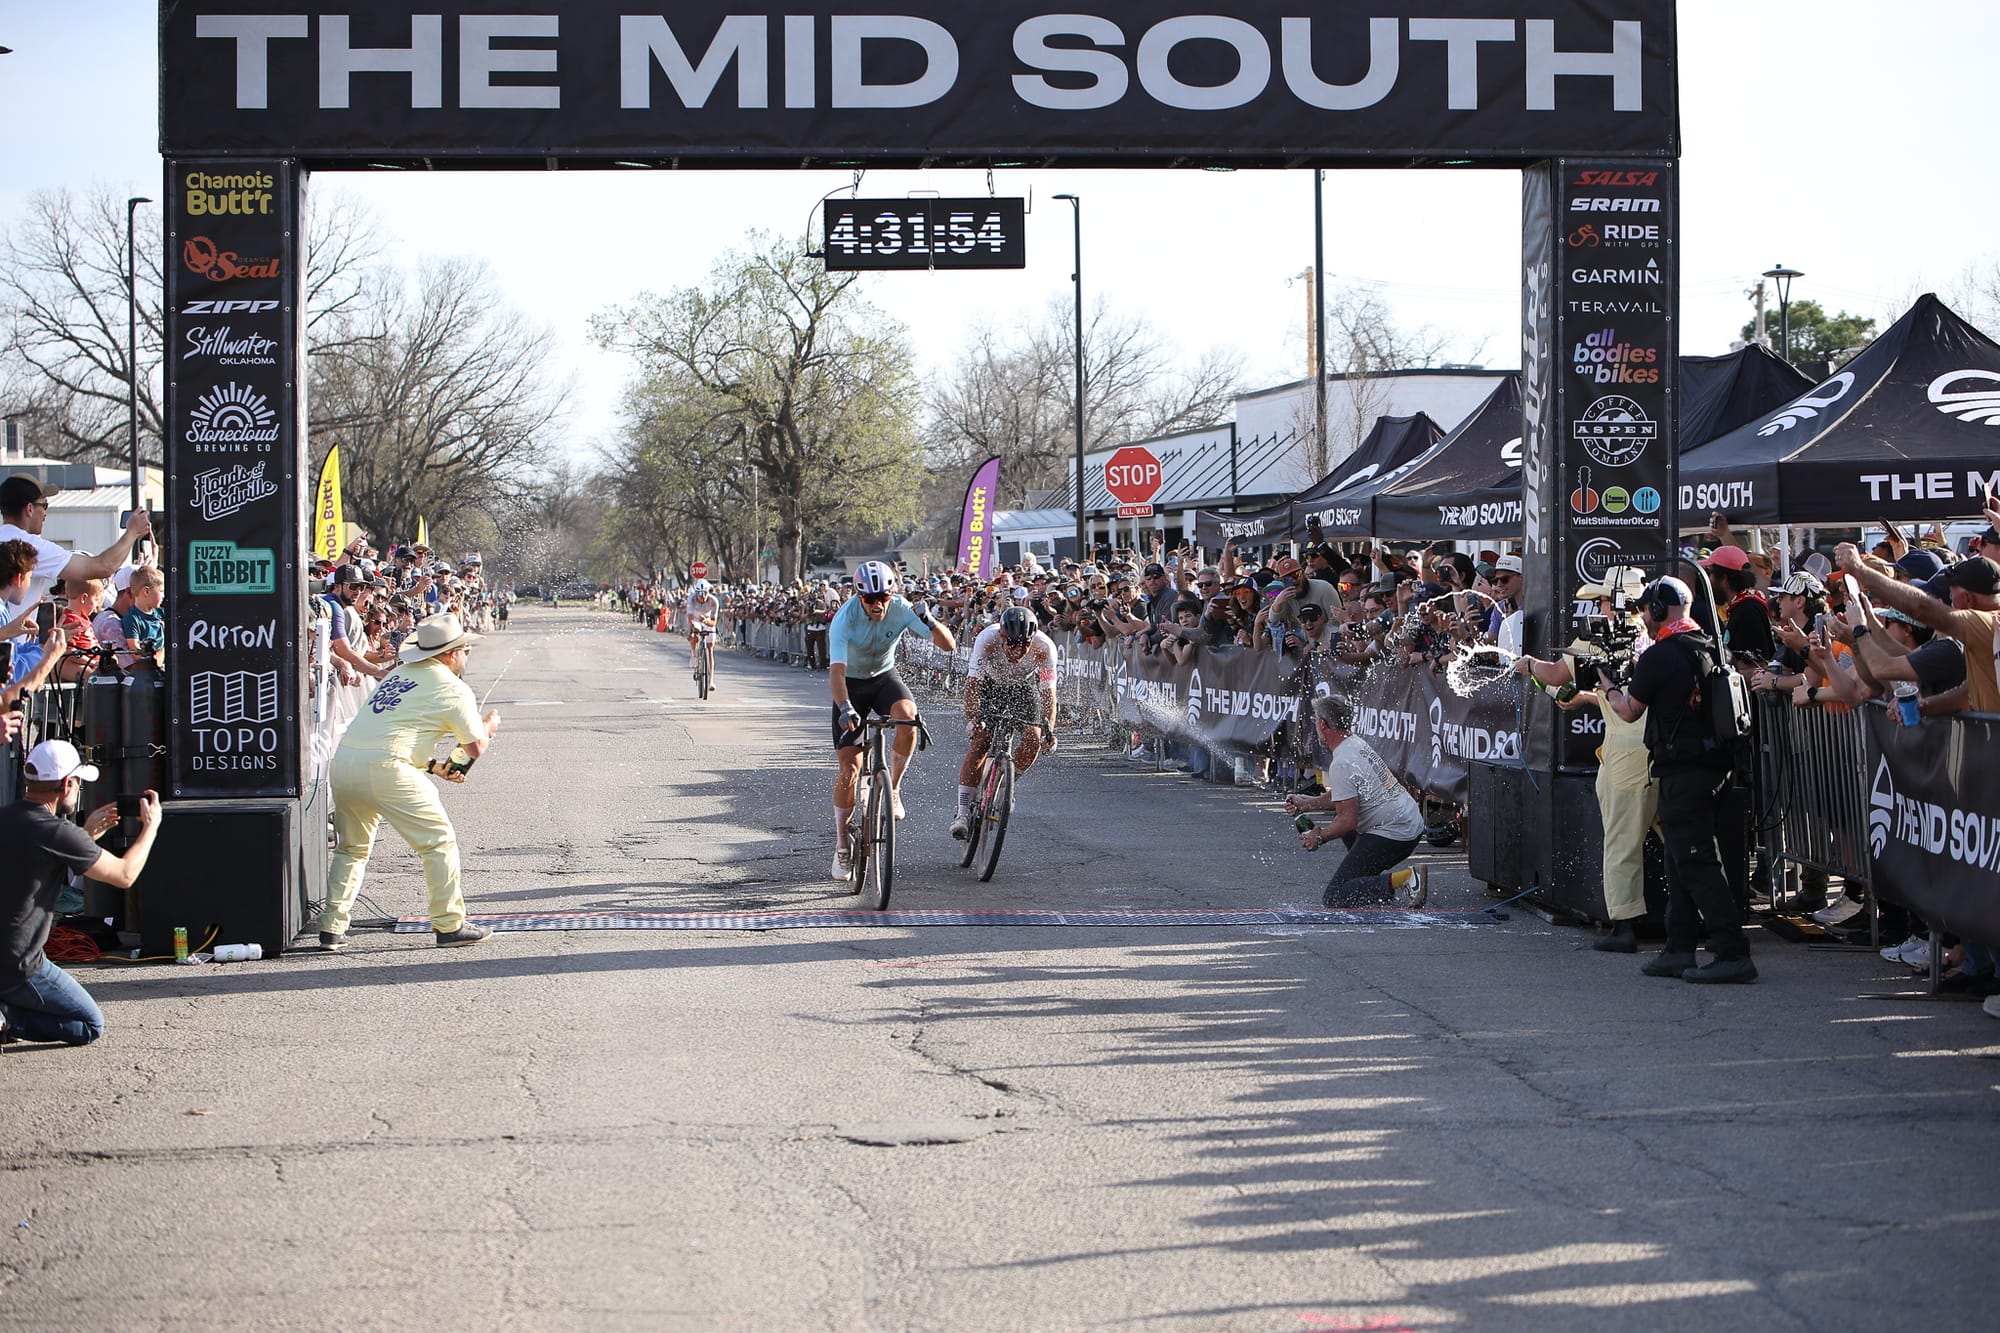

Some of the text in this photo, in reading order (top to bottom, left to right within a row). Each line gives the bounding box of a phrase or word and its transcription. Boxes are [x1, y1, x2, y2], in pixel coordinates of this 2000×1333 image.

[196, 14, 1643, 111] THE MID SOUTH
[185, 172, 273, 190] Chamois
[1573, 171, 1659, 186] SALSA
[187, 190, 273, 215] Butt'r
[1570, 198, 1661, 213] SRAM
[829, 211, 1006, 254] 4:31:54
[1604, 225, 1659, 240] RIDE
[206, 251, 280, 282] Seal
[1571, 268, 1661, 284] GARMIN
[181, 301, 280, 314] ZIPP
[1569, 301, 1661, 314] TERAVAIL
[184, 326, 279, 360] Stillwater
[1586, 329, 1615, 347] all
[1573, 343, 1657, 363] bodies
[1576, 364, 1593, 375] on
[1594, 364, 1659, 383] bikes
[1587, 398, 1643, 420] COFFEE
[185, 420, 280, 443] Stonecloud
[1577, 426, 1654, 434] ASPEN
[195, 444, 271, 452] BREWING CO
[1585, 439, 1644, 464] COMPANY
[1108, 463, 1158, 487] STOP
[1860, 470, 2000, 501] THE M
[203, 478, 278, 521] Leadville
[1679, 481, 1753, 511] ID SOUTH
[1136, 507, 1150, 515] WAY
[1438, 500, 1522, 526] THE MID SOUTH
[1572, 516, 1660, 527] VisitStillwaterOK.org
[1243, 519, 1265, 538] SOUTH
[194, 545, 232, 560] FUZZY
[194, 560, 271, 585] RABBIT
[691, 566, 707, 575] STOP
[188, 619, 277, 650] RIPTON
[1206, 688, 1230, 715] THE
[1251, 693, 1300, 722] SOUTH
[1357, 706, 1378, 736] MID
[1378, 709, 1417, 743] SOUTH
[191, 728, 278, 753] TOPO
[1443, 722, 1459, 756] THE
[1459, 725, 1491, 759] MID
[193, 755, 277, 770] DESIGNS
[1895, 792, 1920, 846] THE
